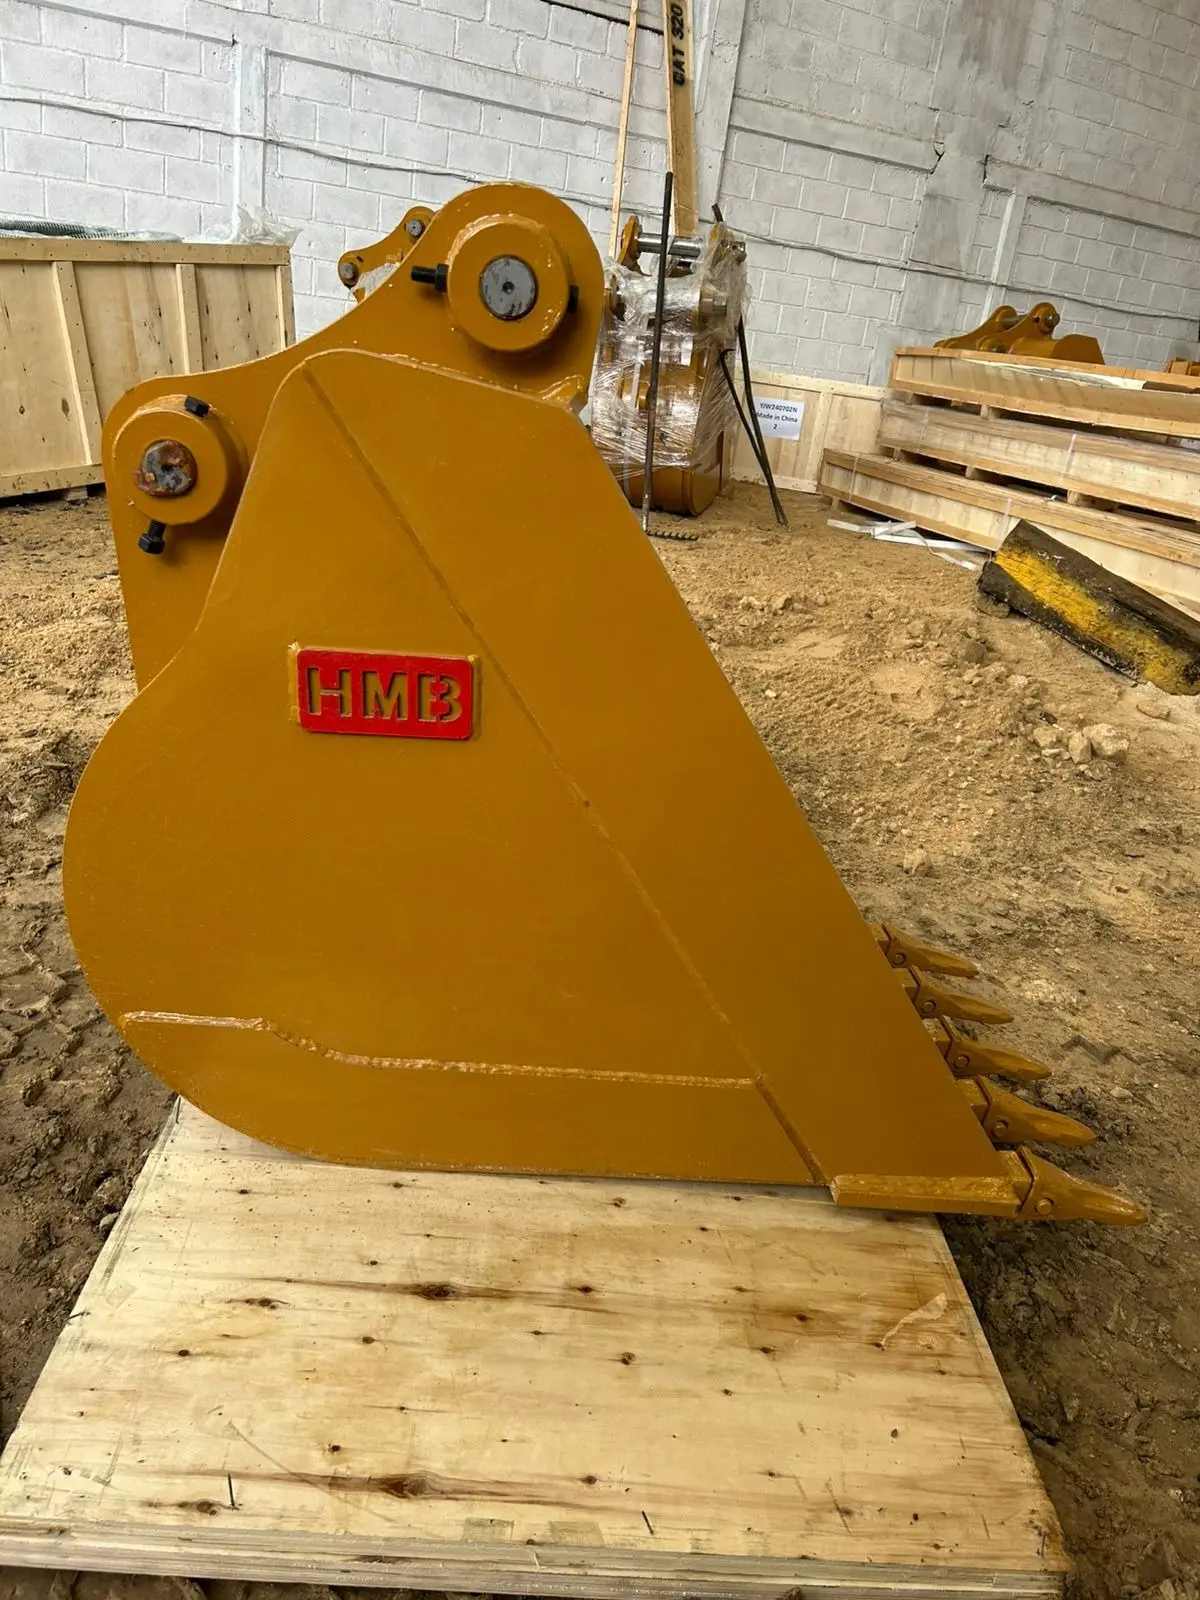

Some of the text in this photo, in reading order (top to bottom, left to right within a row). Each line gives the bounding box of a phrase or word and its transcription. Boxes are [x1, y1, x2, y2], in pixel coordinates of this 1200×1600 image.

[670, 3, 686, 87] CAT 320
[774, 413, 780, 421] in
[781, 415, 798, 423] China
[307, 666, 462, 723] HMB
